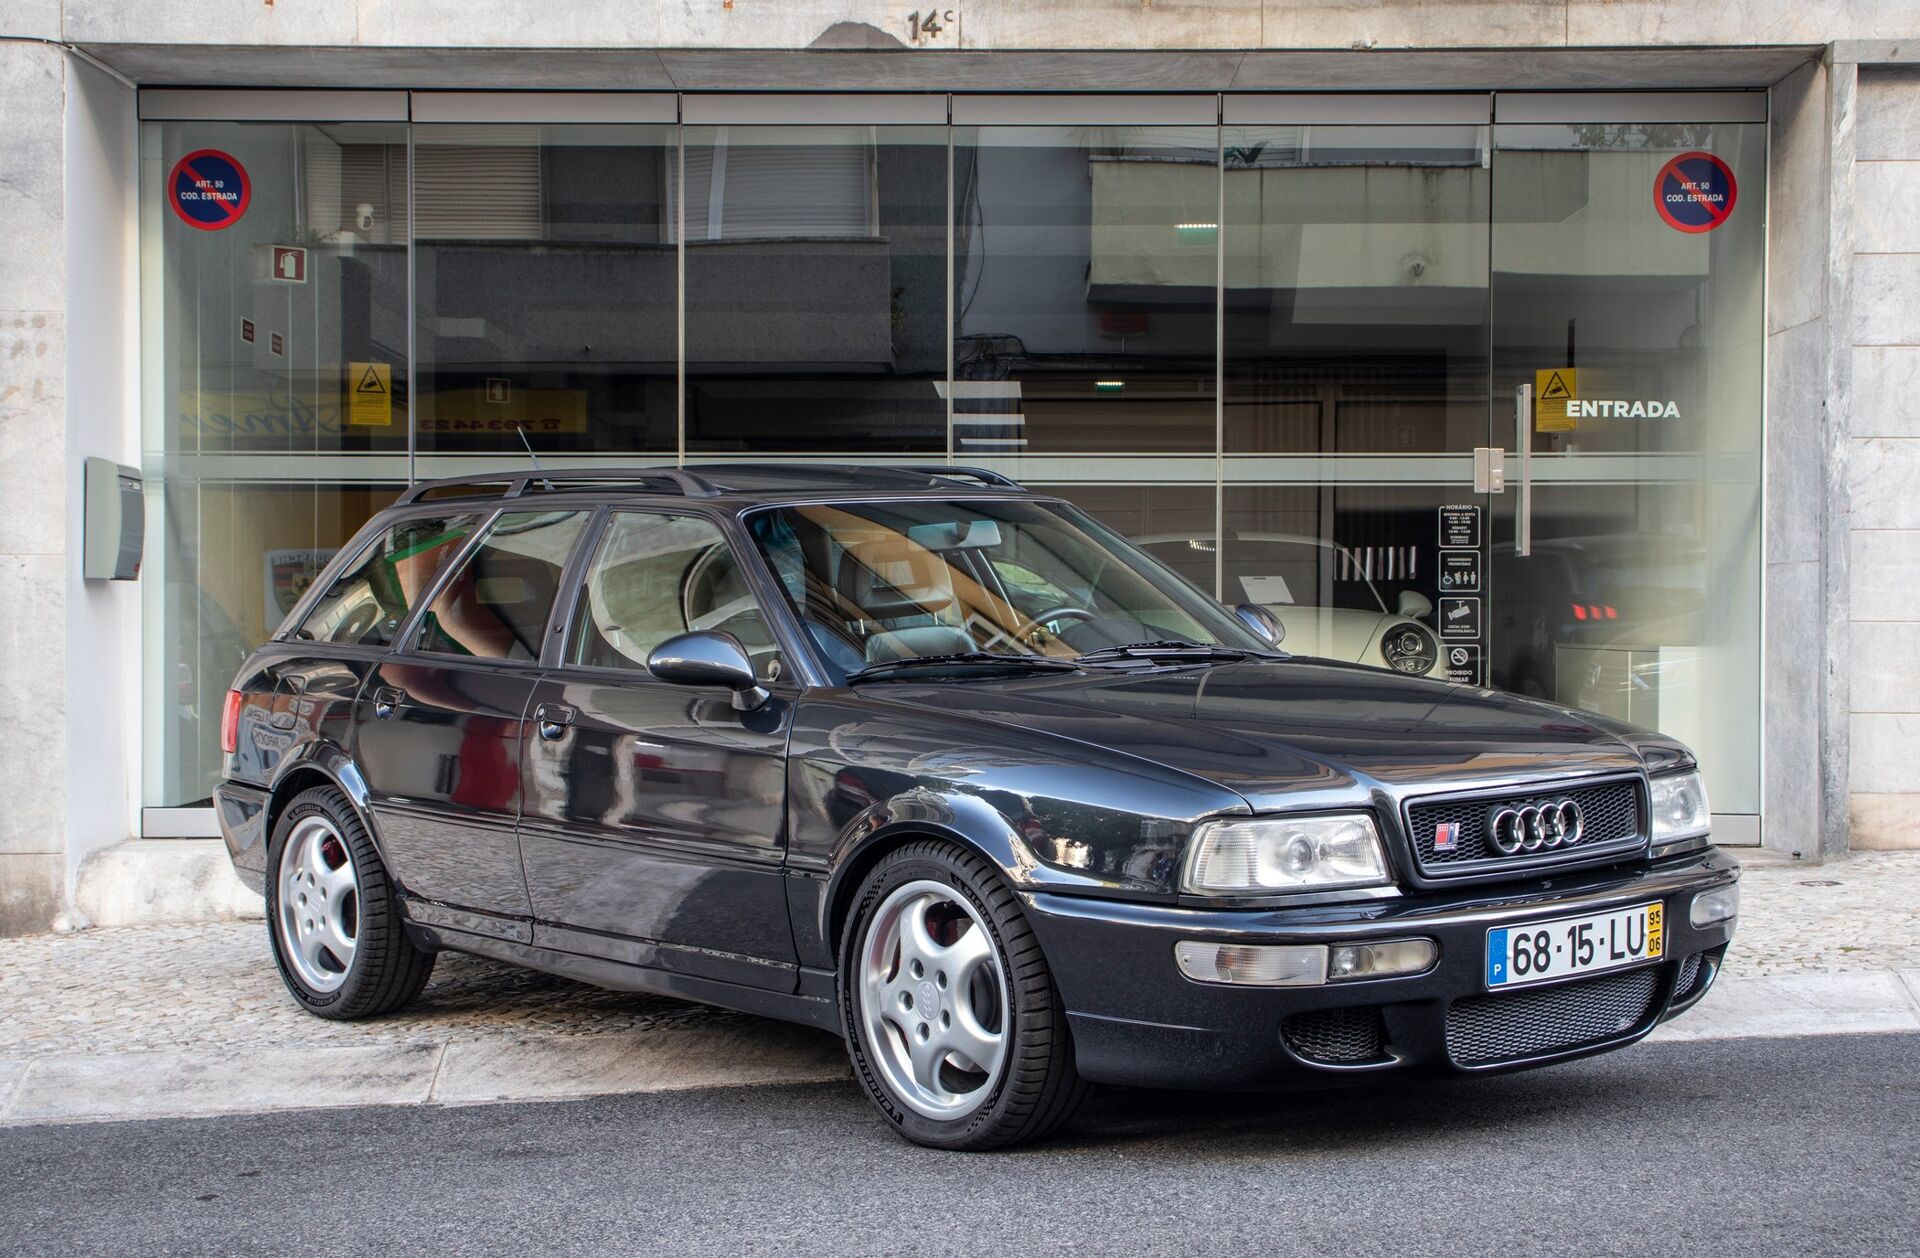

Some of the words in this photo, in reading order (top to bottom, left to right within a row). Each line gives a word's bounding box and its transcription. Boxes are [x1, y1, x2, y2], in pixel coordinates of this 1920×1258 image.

[195, 180, 213, 188] ART.
[215, 180, 224, 188] 50
[1681, 182, 1699, 190] ART.
[1701, 182, 1710, 190] 50
[181, 192, 200, 200] COD.
[202, 192, 238, 200] ESTRADA
[1666, 194, 1685, 202] COD.
[1687, 194, 1723, 202] ESTRADA
[1566, 400, 1680, 418] ENTRADA
[963, 886, 1003, 946] MICHELIN
[1649, 911, 1661, 926] 95
[1649, 936, 1661, 952] 06
[1494, 964, 1502, 976] P
[856, 1050, 892, 1112] MICHELIN
